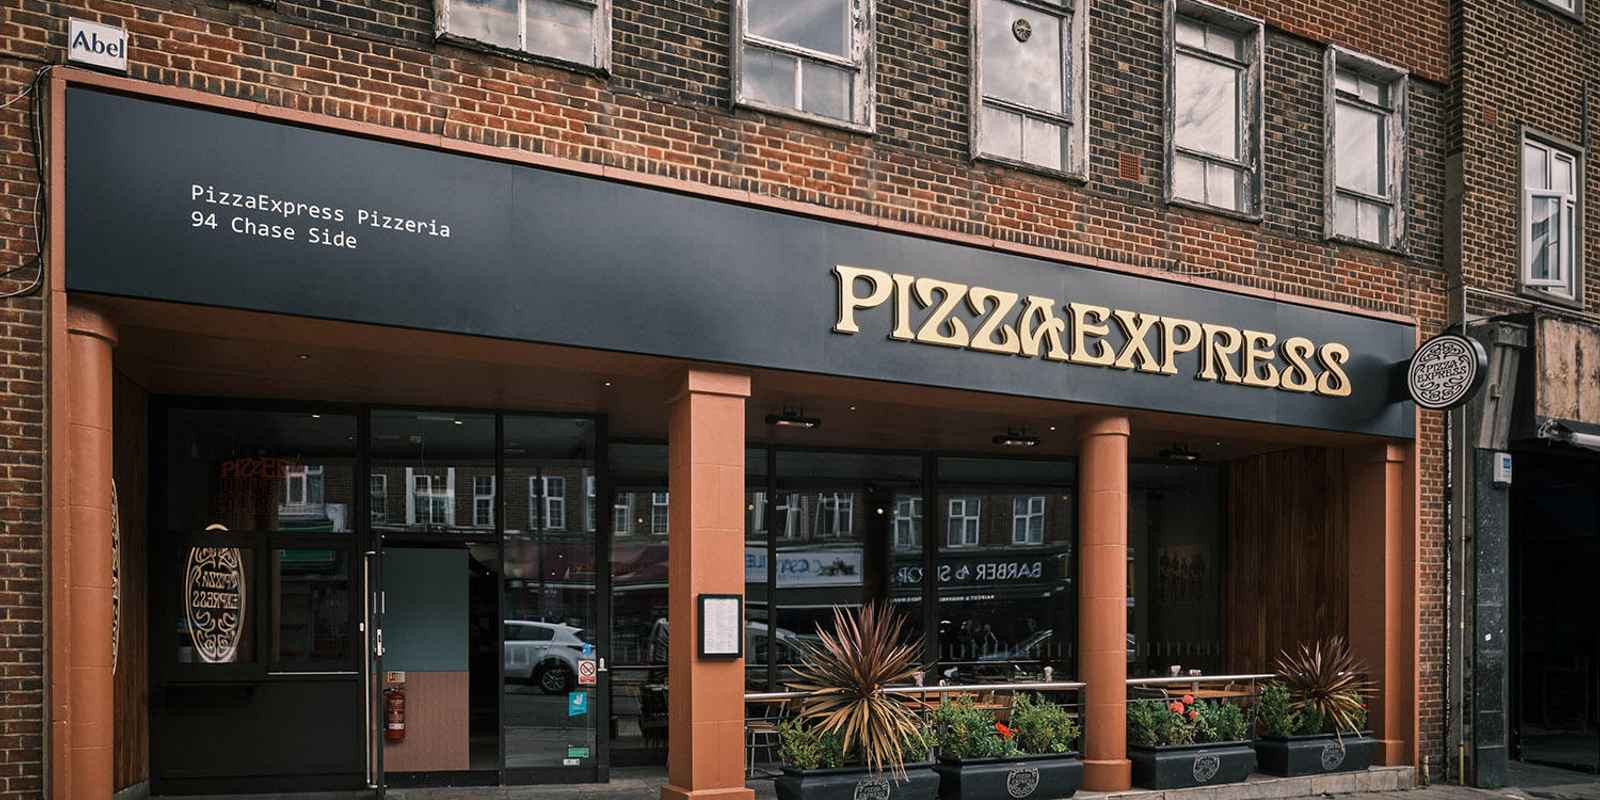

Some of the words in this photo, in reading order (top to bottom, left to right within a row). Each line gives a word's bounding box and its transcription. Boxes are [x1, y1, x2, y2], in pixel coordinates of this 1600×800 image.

[72, 30, 125, 59] Abel
[190, 184, 345, 222] PizzaExpress
[357, 208, 451, 238] Pizzeria
[191, 211, 218, 230] 94
[231, 217, 296, 241] Chase
[308, 227, 358, 249] Side
[832, 264, 1353, 397] PIZZAEXPRESS
[1417, 366, 1467, 383] EXPRESS
[1426, 360, 1458, 373] PIZZA
